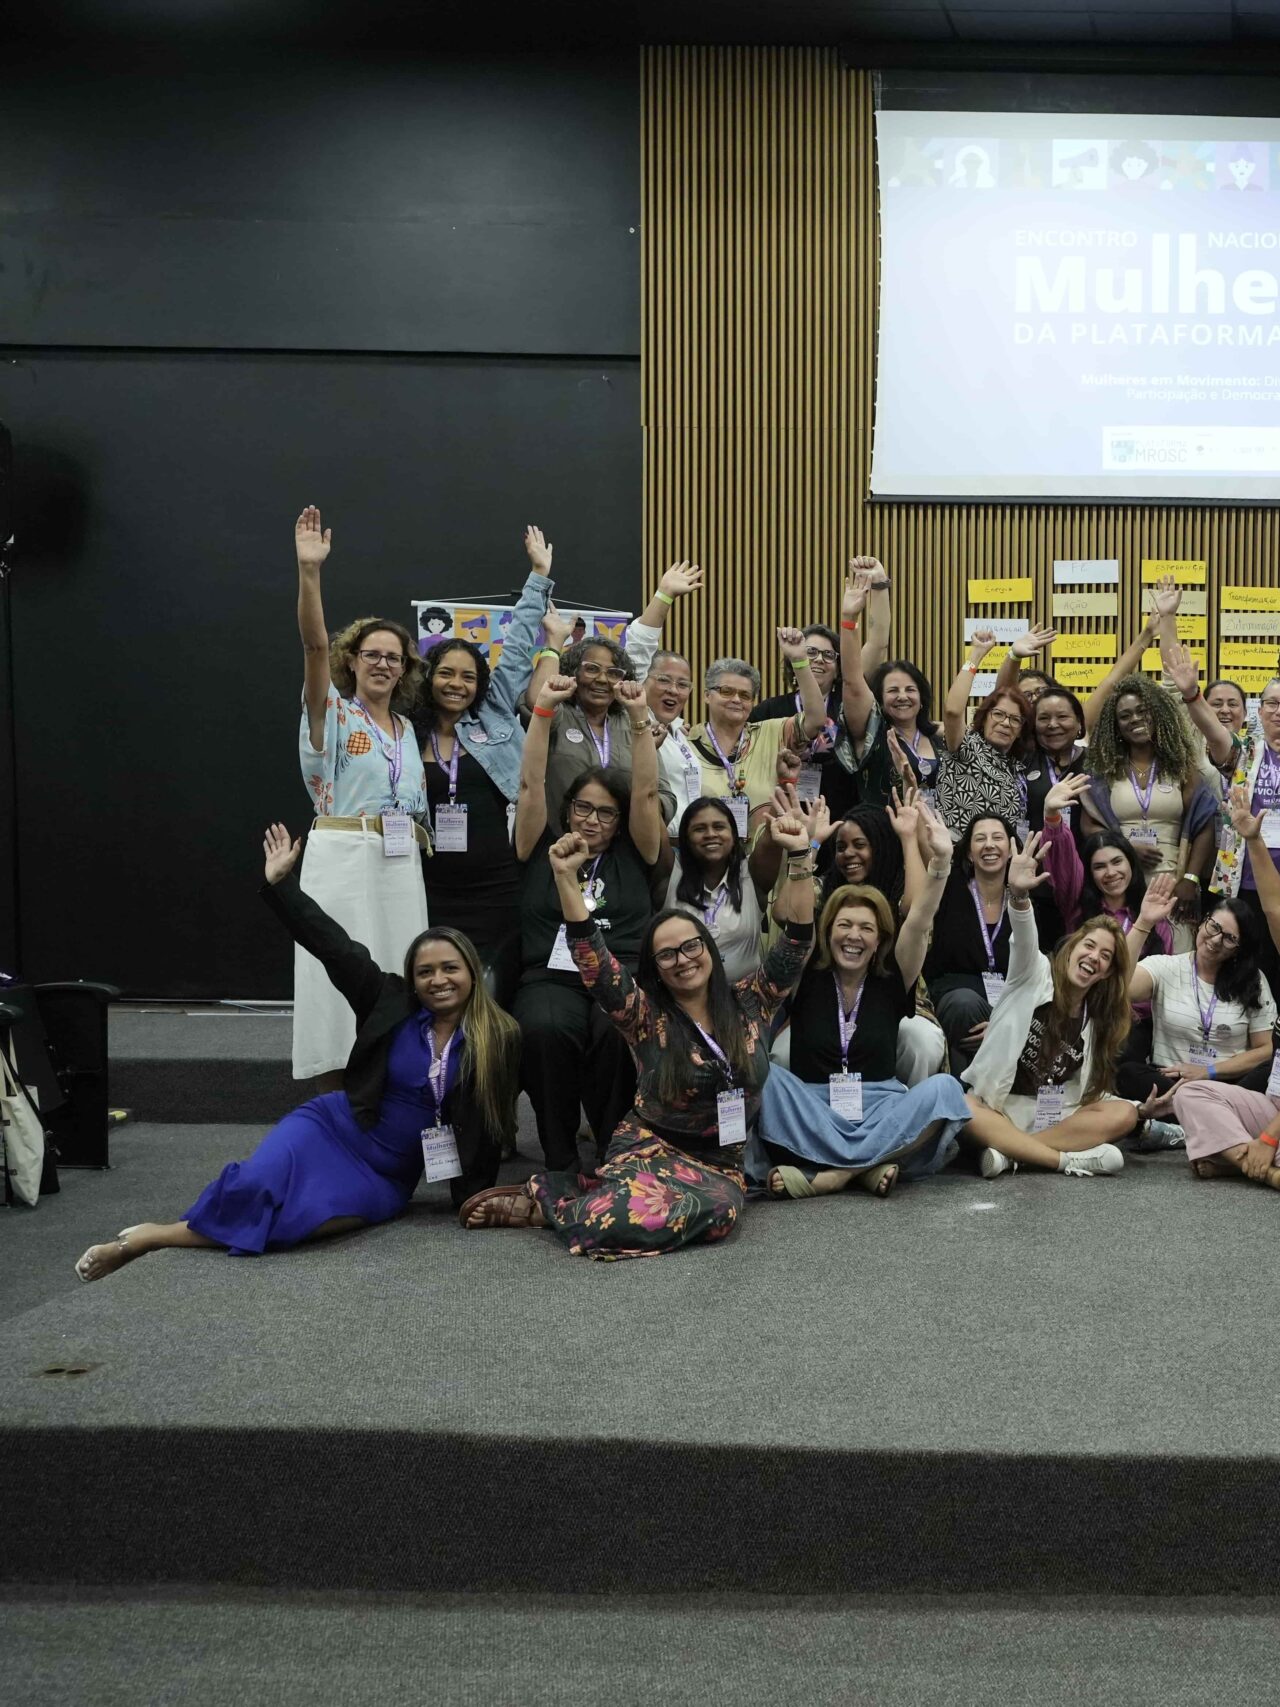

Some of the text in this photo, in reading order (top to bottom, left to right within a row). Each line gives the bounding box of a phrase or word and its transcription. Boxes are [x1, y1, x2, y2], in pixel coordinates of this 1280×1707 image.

[1015, 230, 1138, 248] ENCONTRO
[1014, 323, 1056, 344] DA
[1081, 374, 1146, 386] Mulheres
[1151, 377, 1172, 386] em
[1177, 375, 1260, 387] Movimento:
[1126, 388, 1206, 403] Participação
[1211, 391, 1218, 401] e
[1136, 449, 1188, 463] MROSC
